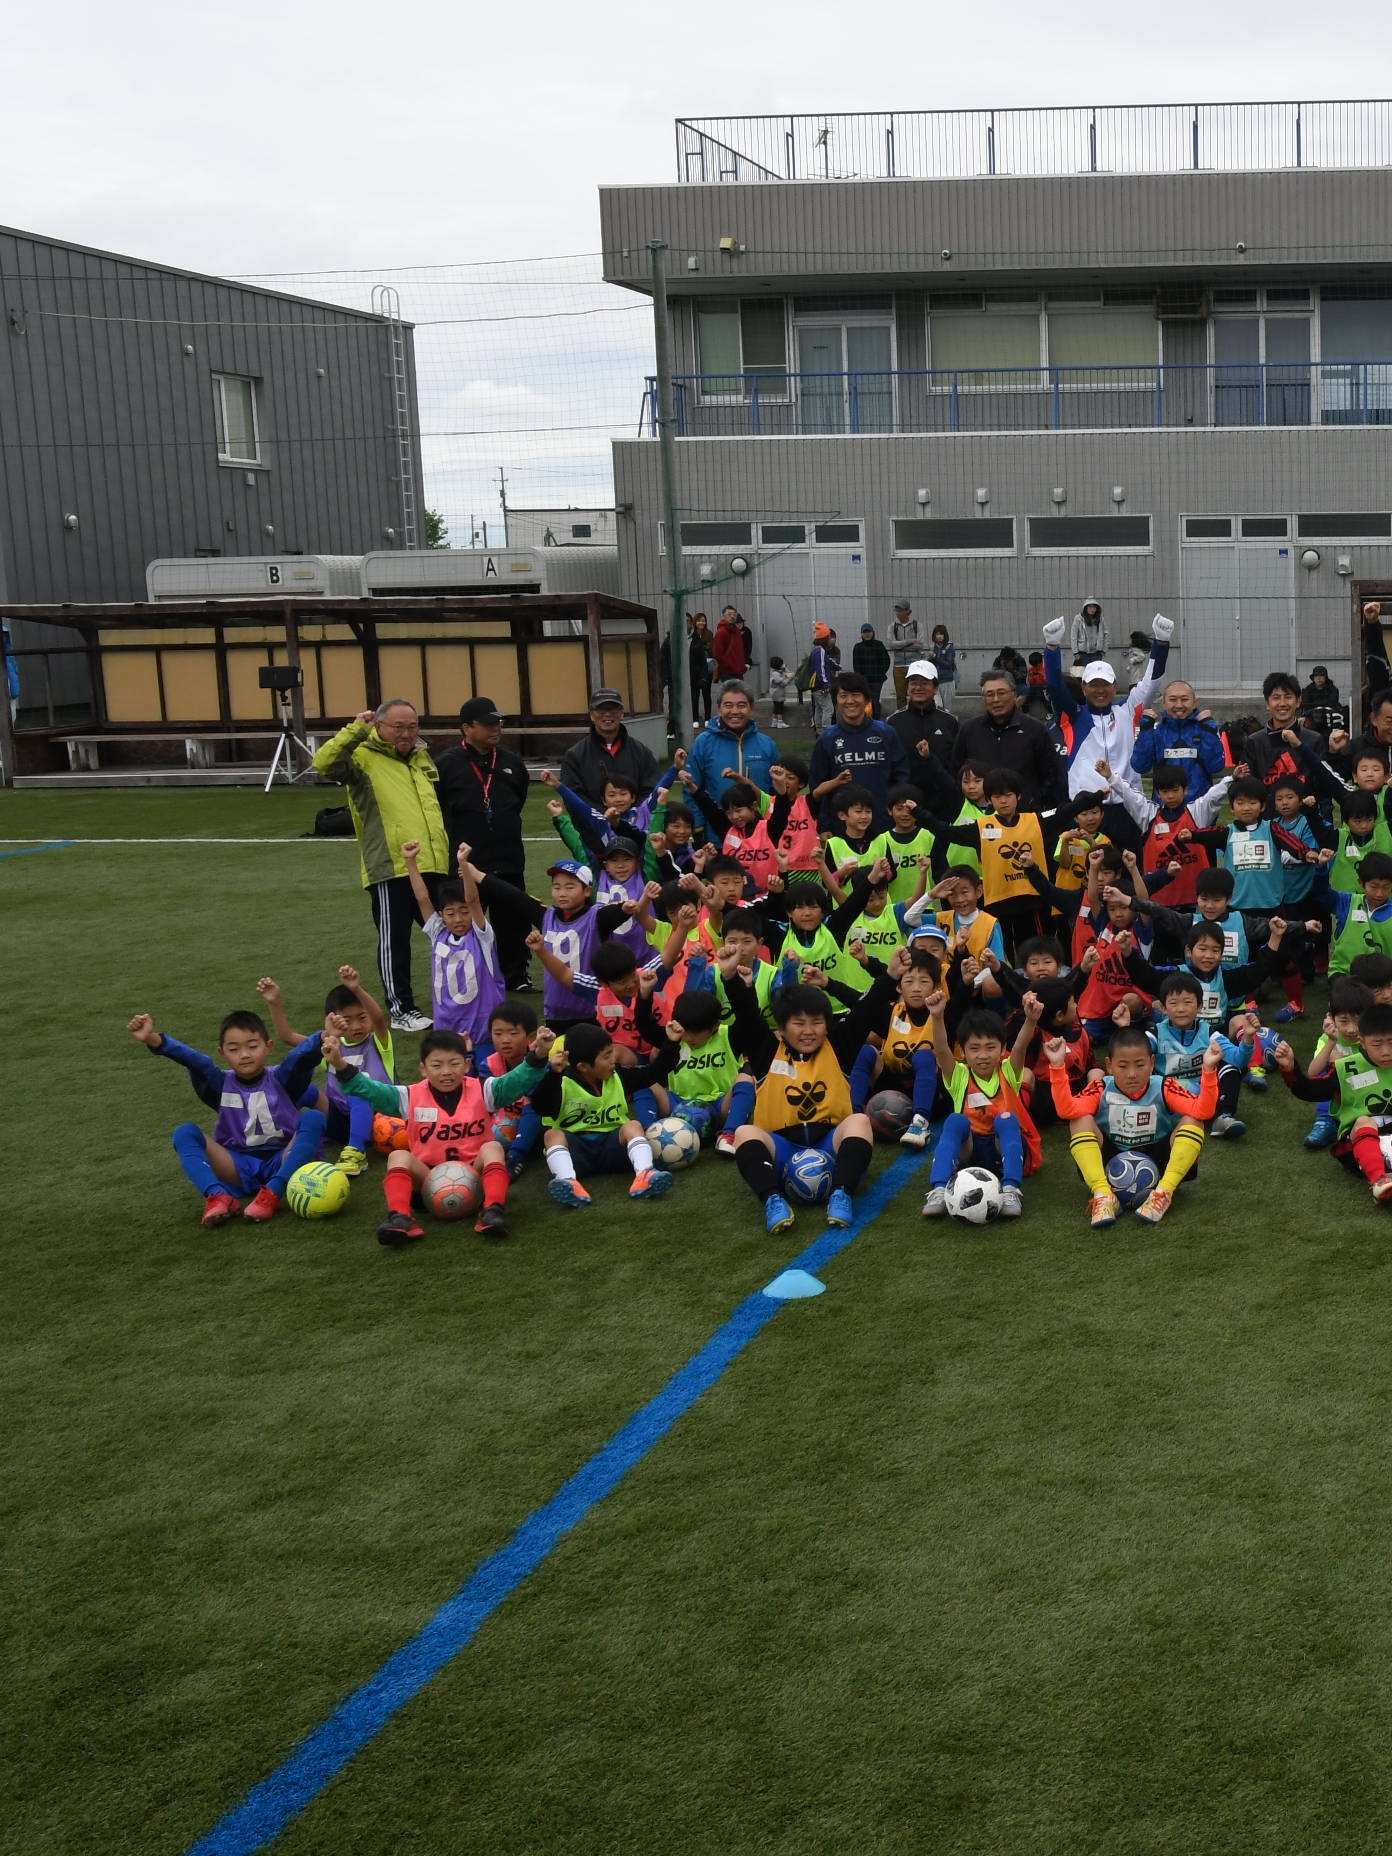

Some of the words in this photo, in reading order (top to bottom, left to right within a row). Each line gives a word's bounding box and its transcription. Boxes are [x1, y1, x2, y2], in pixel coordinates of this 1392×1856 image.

[270, 566, 280, 584] B
[485, 557, 497, 577] A
[834, 751, 886, 765] KELME
[787, 818, 808, 832] sics
[782, 836, 792, 850] 3
[861, 931, 897, 946] asics
[684, 1051, 725, 1071] asics
[244, 1091, 284, 1147] 4
[437, 1118, 485, 1141] asics
